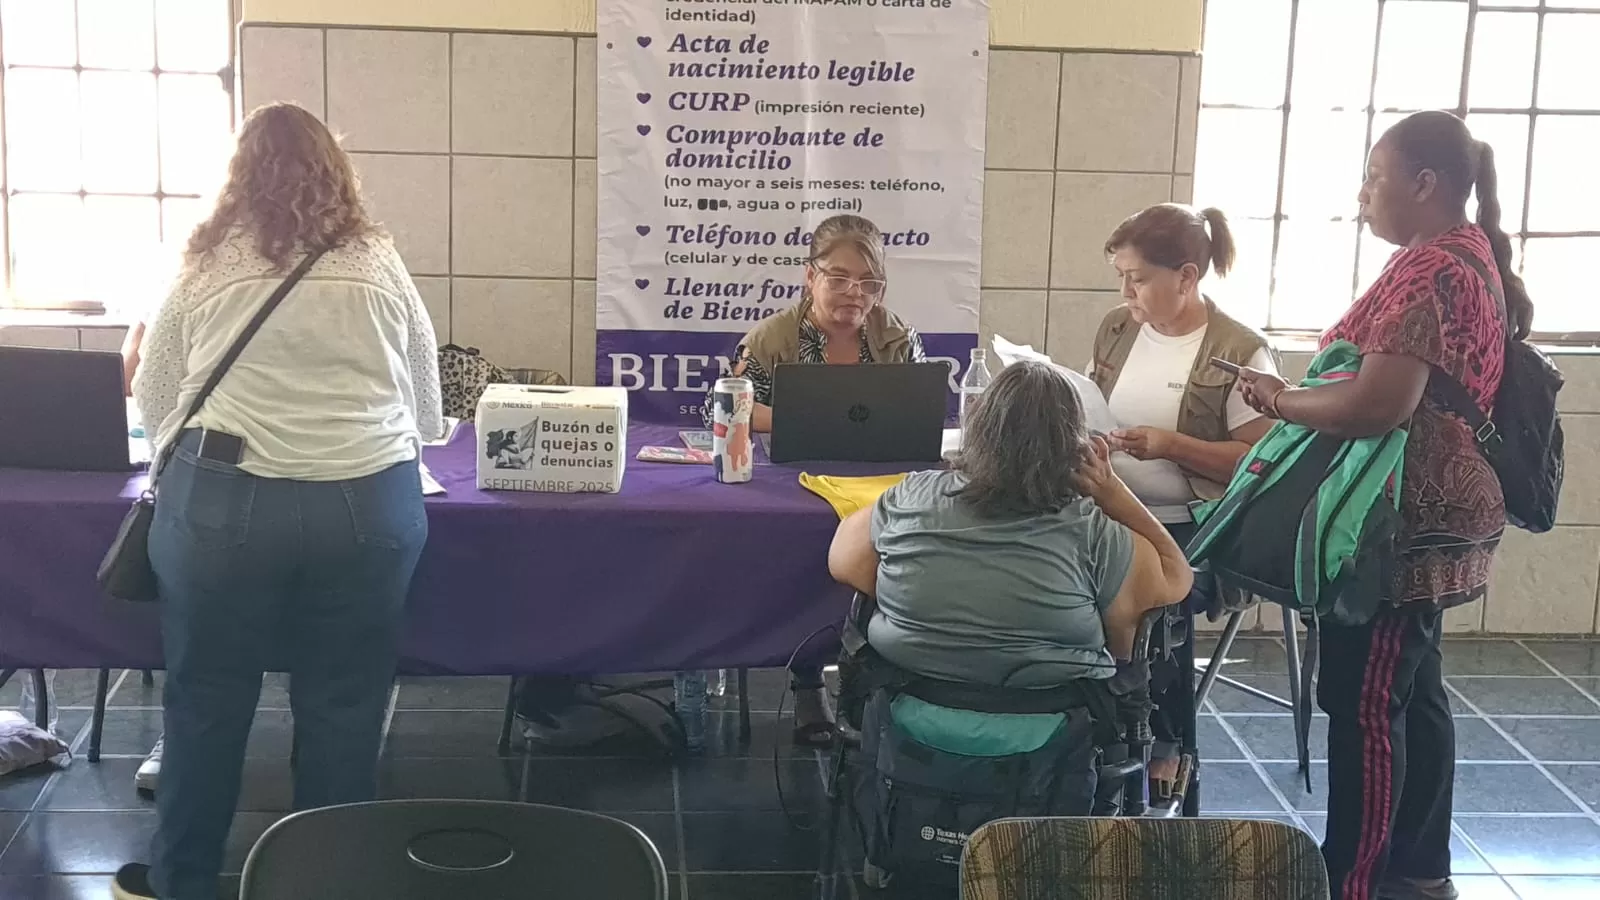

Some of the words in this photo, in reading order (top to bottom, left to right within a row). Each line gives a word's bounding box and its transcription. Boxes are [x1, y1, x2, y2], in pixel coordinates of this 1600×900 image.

[666, 8, 755, 24] identidad)
[667, 34, 731, 53] Acta
[739, 34, 769, 54] de
[669, 57, 820, 79] nacimiento
[828, 60, 914, 86] legible
[669, 92, 750, 111] CURP
[755, 100, 843, 115] (impresión
[850, 102, 924, 118] reciente)
[667, 125, 845, 152] Comprobante
[853, 127, 883, 147] de
[666, 149, 791, 170] domicilio
[665, 175, 691, 189] (no
[697, 178, 750, 190] mayor
[756, 180, 765, 188] a
[771, 177, 803, 189] seis
[809, 179, 864, 189] meses:
[870, 178, 944, 192] teléfono,
[664, 196, 692, 209] luz,
[737, 200, 779, 212] agua
[785, 201, 795, 209] o
[801, 198, 862, 213] predial)
[666, 223, 776, 249] Teléfono
[784, 226, 814, 246] de
[665, 251, 727, 265] (celular
[732, 256, 741, 266] y
[747, 253, 768, 265] de
[664, 277, 754, 297] Llenar
[664, 300, 693, 319] de
[542, 421, 589, 433] Buzón
[596, 422, 614, 434] de
[541, 438, 597, 454] quejas
[604, 442, 613, 451] o
[541, 455, 613, 468] denuncias
[484, 479, 574, 491] SEPTIEMBRE
[580, 481, 613, 492] 2025
